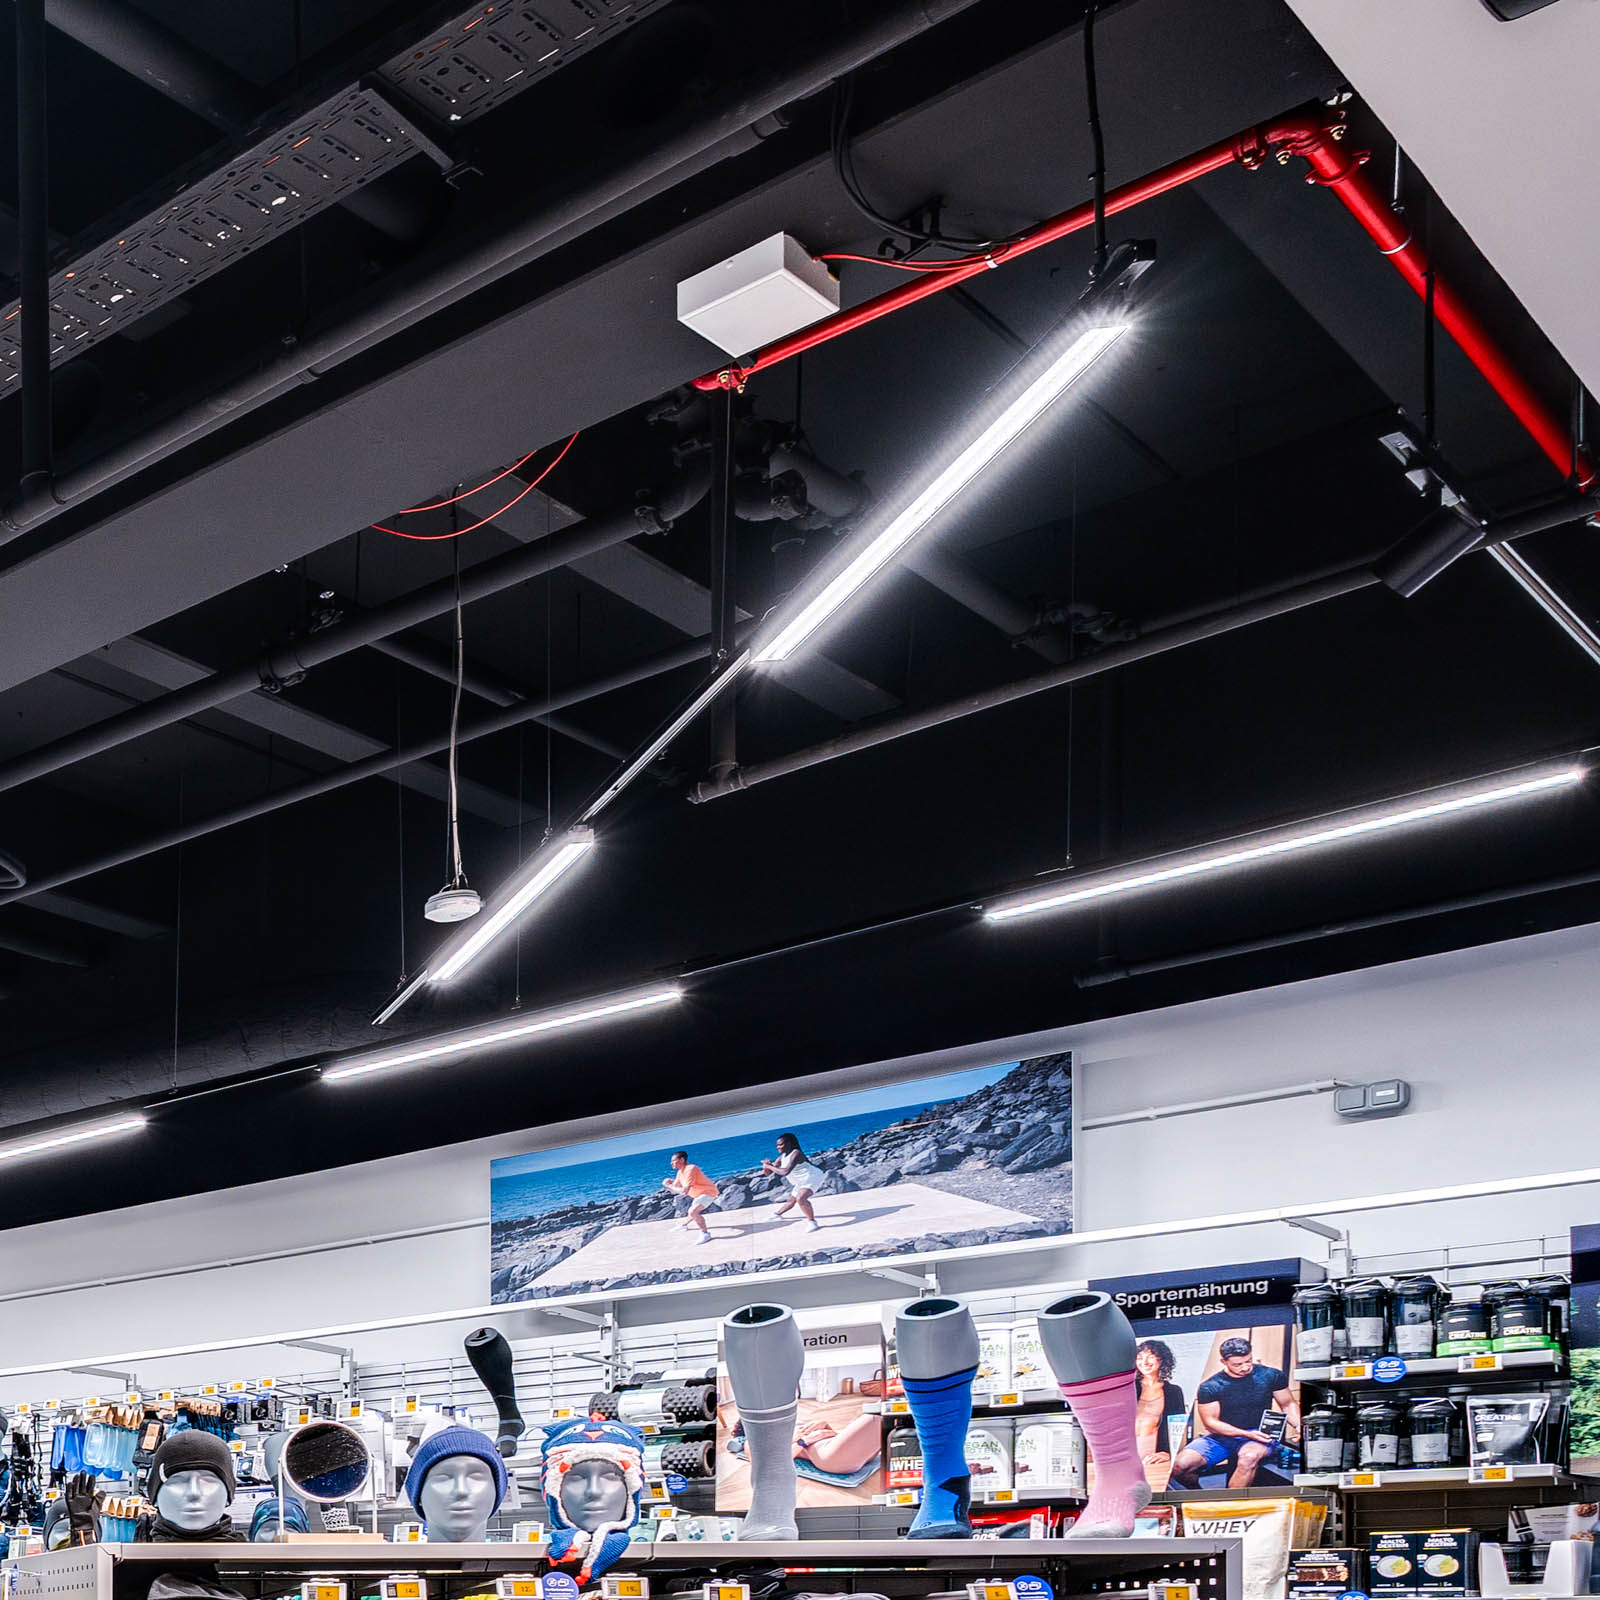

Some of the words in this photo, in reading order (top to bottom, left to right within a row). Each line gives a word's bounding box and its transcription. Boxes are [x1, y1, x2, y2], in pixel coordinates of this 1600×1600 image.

[1114, 1279, 1269, 1308] Sporternährung
[1154, 1302, 1226, 1319] Fitness
[1191, 1519, 1256, 1535] WHEY
